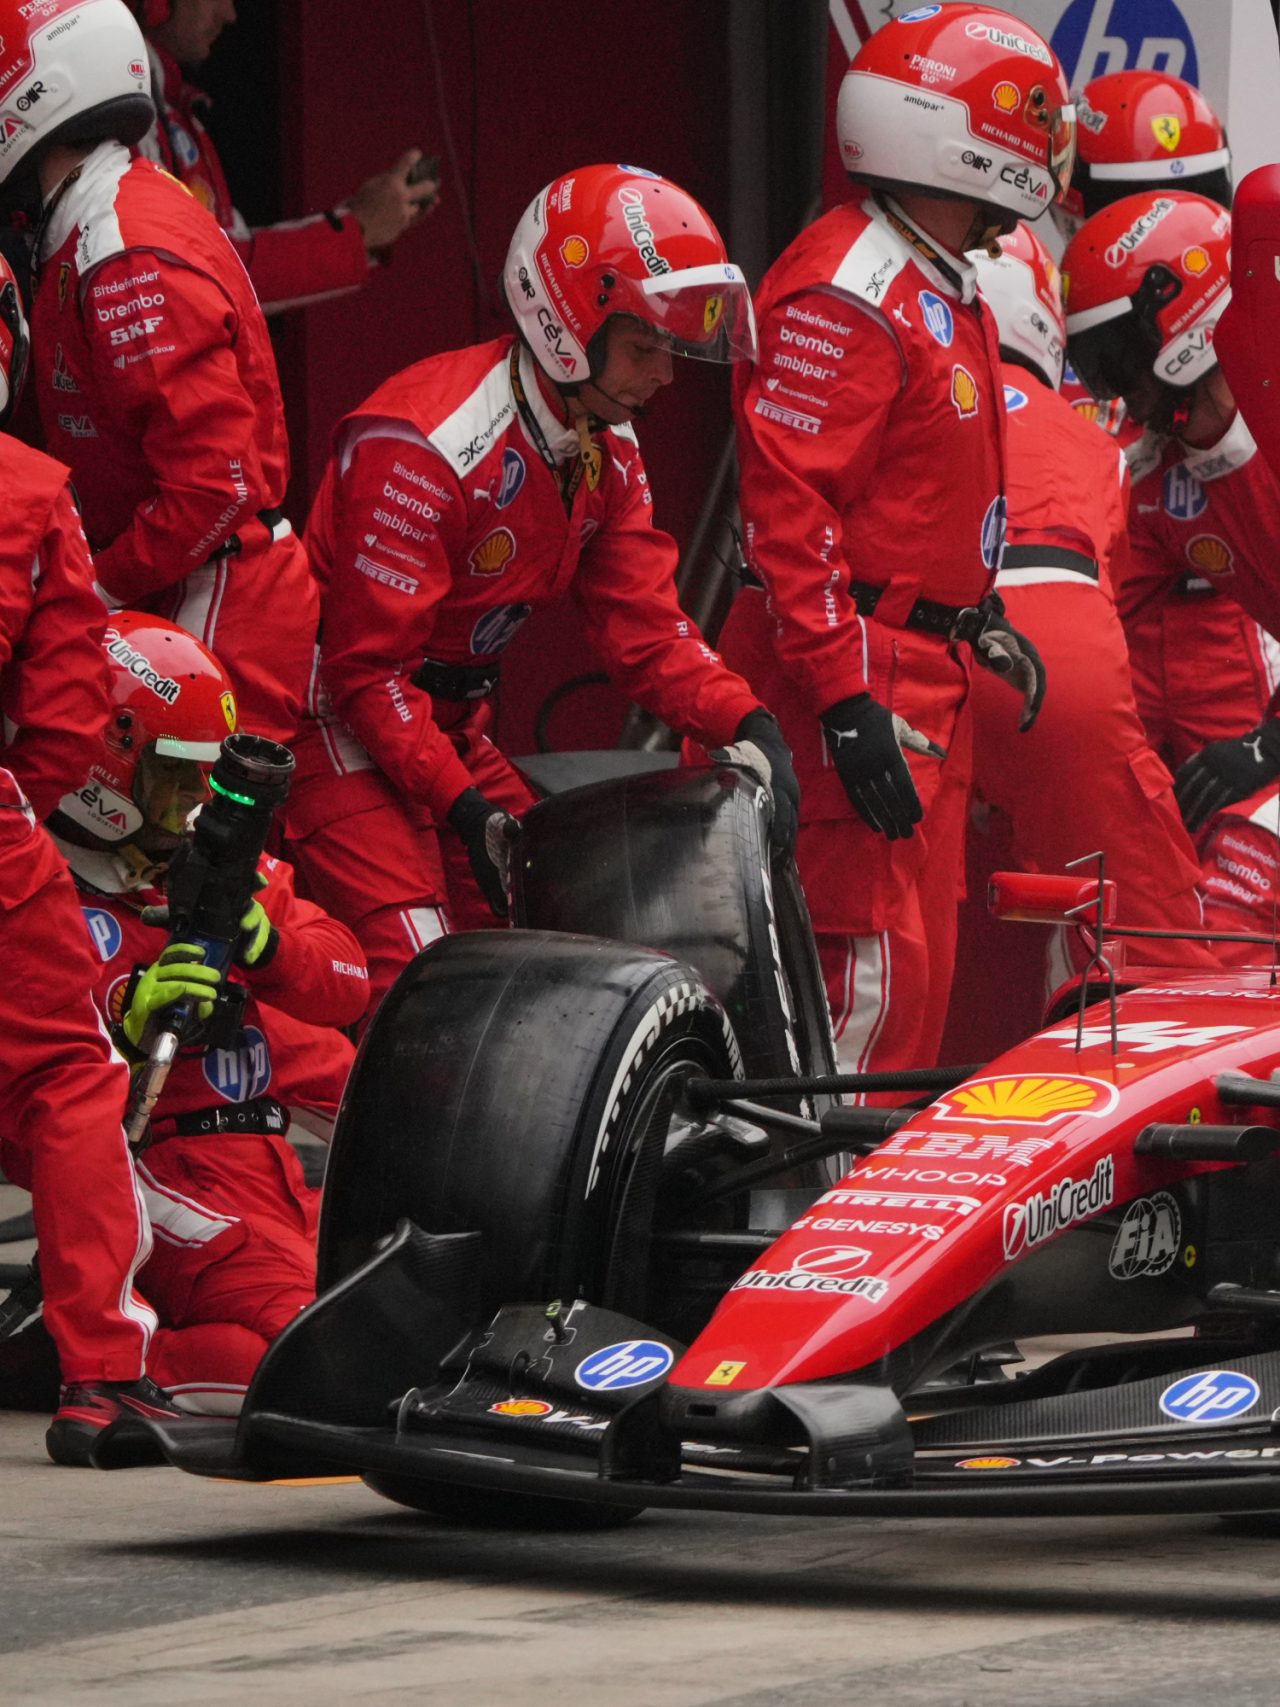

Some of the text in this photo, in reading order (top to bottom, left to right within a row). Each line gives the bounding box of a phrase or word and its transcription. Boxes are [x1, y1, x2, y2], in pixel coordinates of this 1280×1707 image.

[911, 54, 957, 78] PERONI
[904, 94, 940, 111] ambipar
[981, 122, 1044, 158] RICHARD MILLE
[621, 199, 672, 276] UniCredit
[93, 270, 161, 298] Bitdefender
[97, 293, 165, 323] brembo
[561, 299, 583, 331] MILLE
[785, 306, 853, 337] Bitdefender
[110, 316, 164, 347] SKF
[779, 325, 845, 360] brembo
[773, 352, 831, 381] ambipar
[754, 396, 822, 435] PIRELLI
[457, 435, 485, 468] DXC
[393, 460, 455, 504] Bitdefender
[383, 481, 441, 523] brembo
[372, 507, 432, 543] ambipar
[353, 552, 420, 596] PIRELLI
[106, 638, 181, 703] UniCredit
[1217, 855, 1272, 892] brembo
[1035, 1020, 1257, 1054] 44
[870, 1131, 1056, 1167] IBM
[847, 1165, 1008, 1187] WHOOP
[812, 1190, 982, 1216] PIRELLI
[1024, 1153, 1115, 1247] UniCredit
[811, 1217, 946, 1241] GENESYS
[731, 1269, 889, 1304] UniCredit
[583, 1341, 664, 1389] hp
[1167, 1372, 1252, 1421] hp
